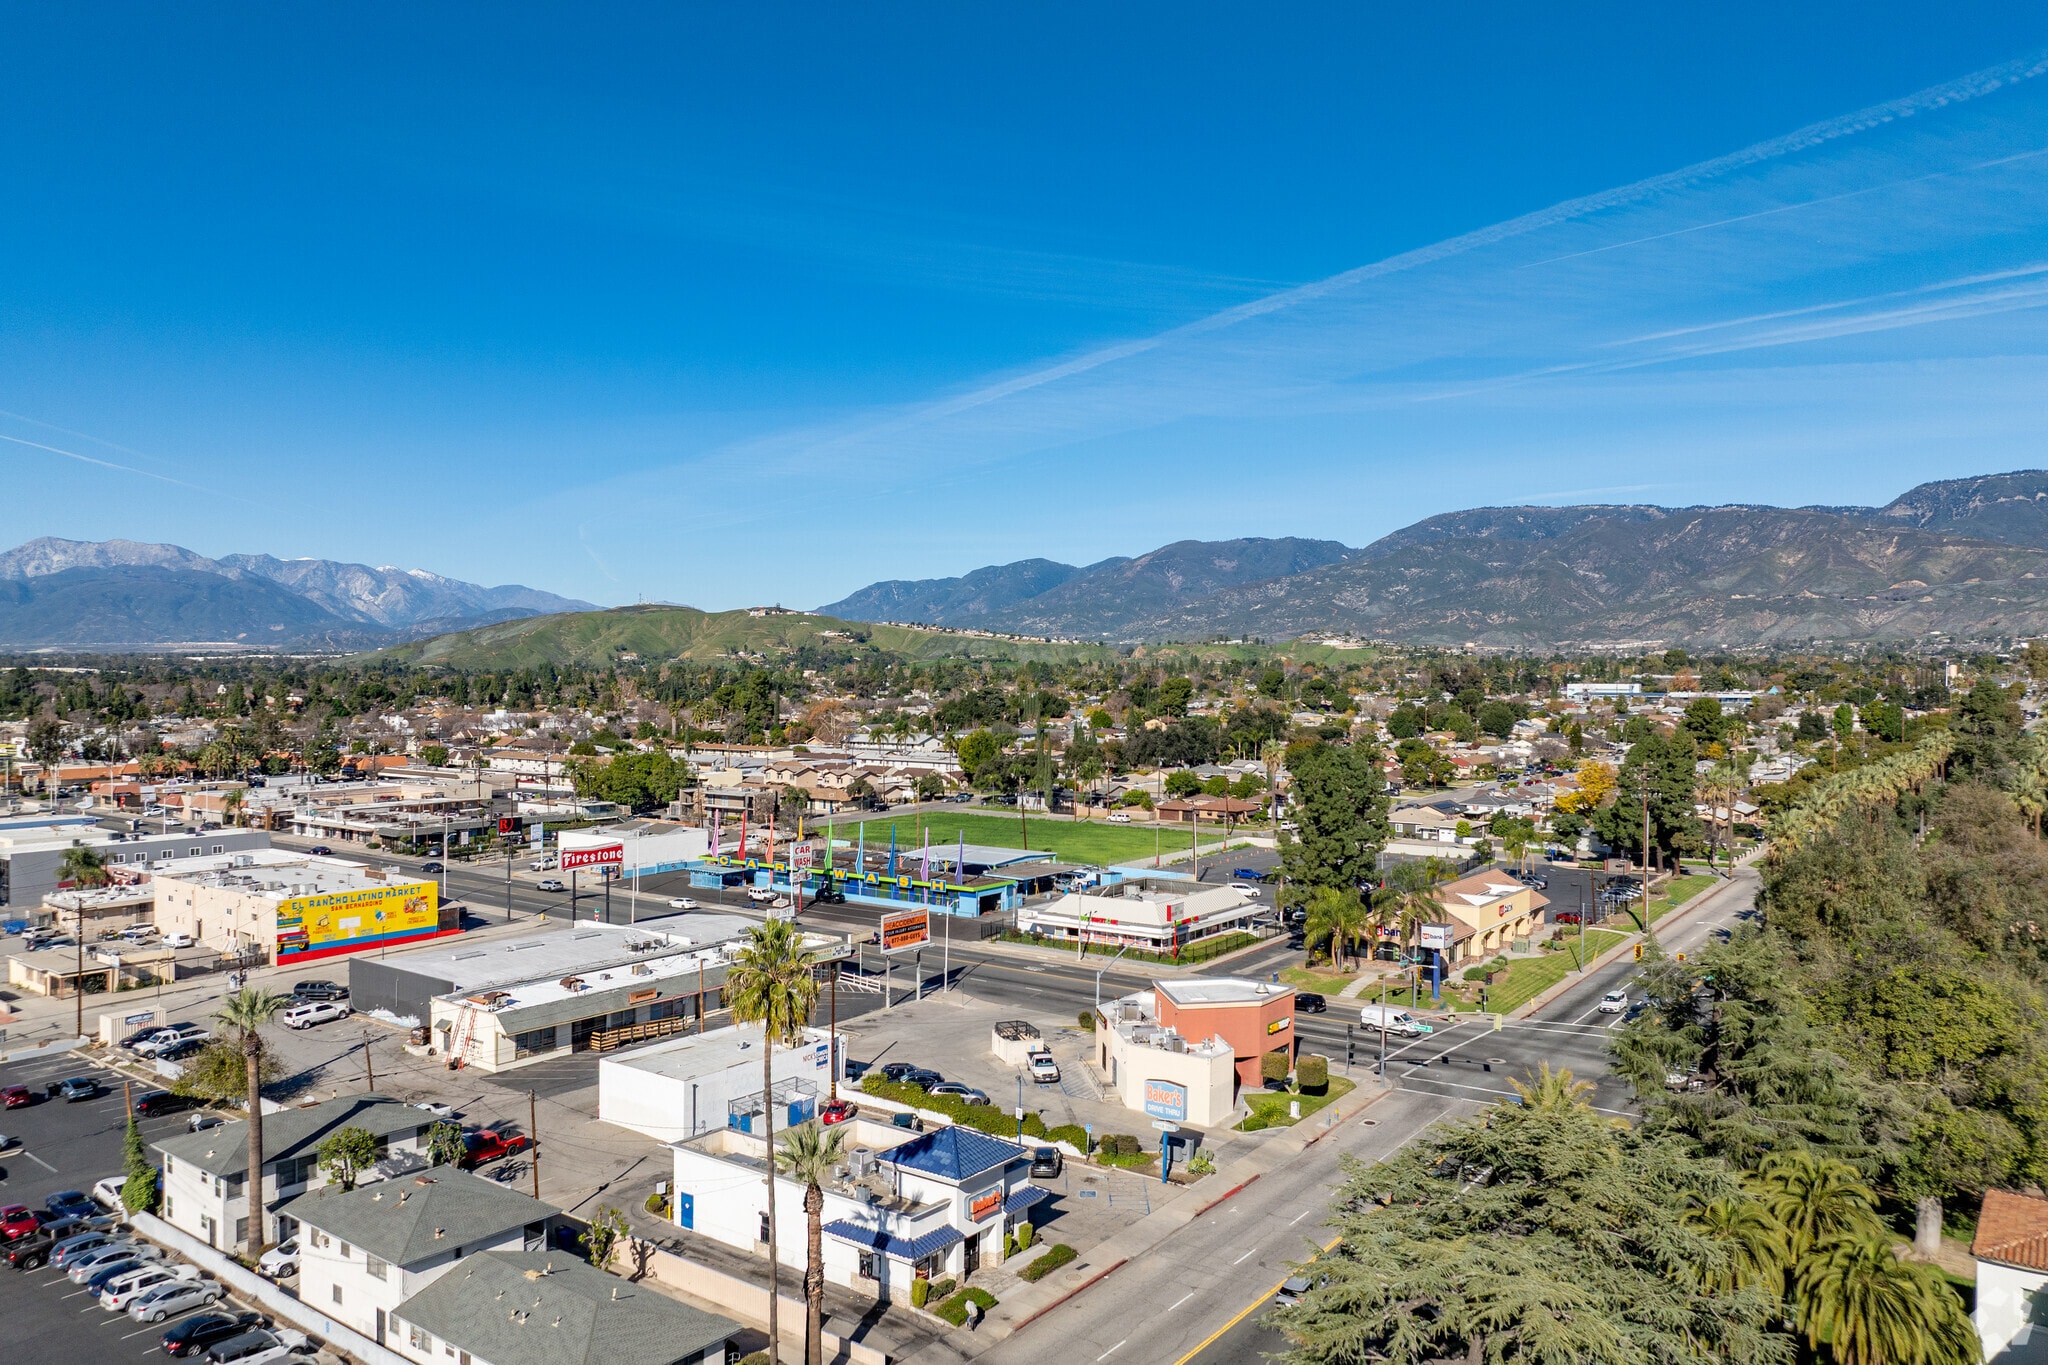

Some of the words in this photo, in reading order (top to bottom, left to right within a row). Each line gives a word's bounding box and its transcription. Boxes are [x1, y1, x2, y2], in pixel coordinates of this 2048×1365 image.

[794, 845, 811, 855] CAR
[563, 849, 622, 867] Firestone
[793, 856, 811, 867] WASH
[292, 901, 304, 910] EL
[309, 896, 348, 907] RANCHO
[350, 891, 383, 903] LATINO
[385, 886, 421, 898] MARKET
[1146, 1083, 1182, 1107] Baker's
[1147, 1104, 1164, 1114] DRIVE
[1165, 1107, 1181, 1117] THRU
